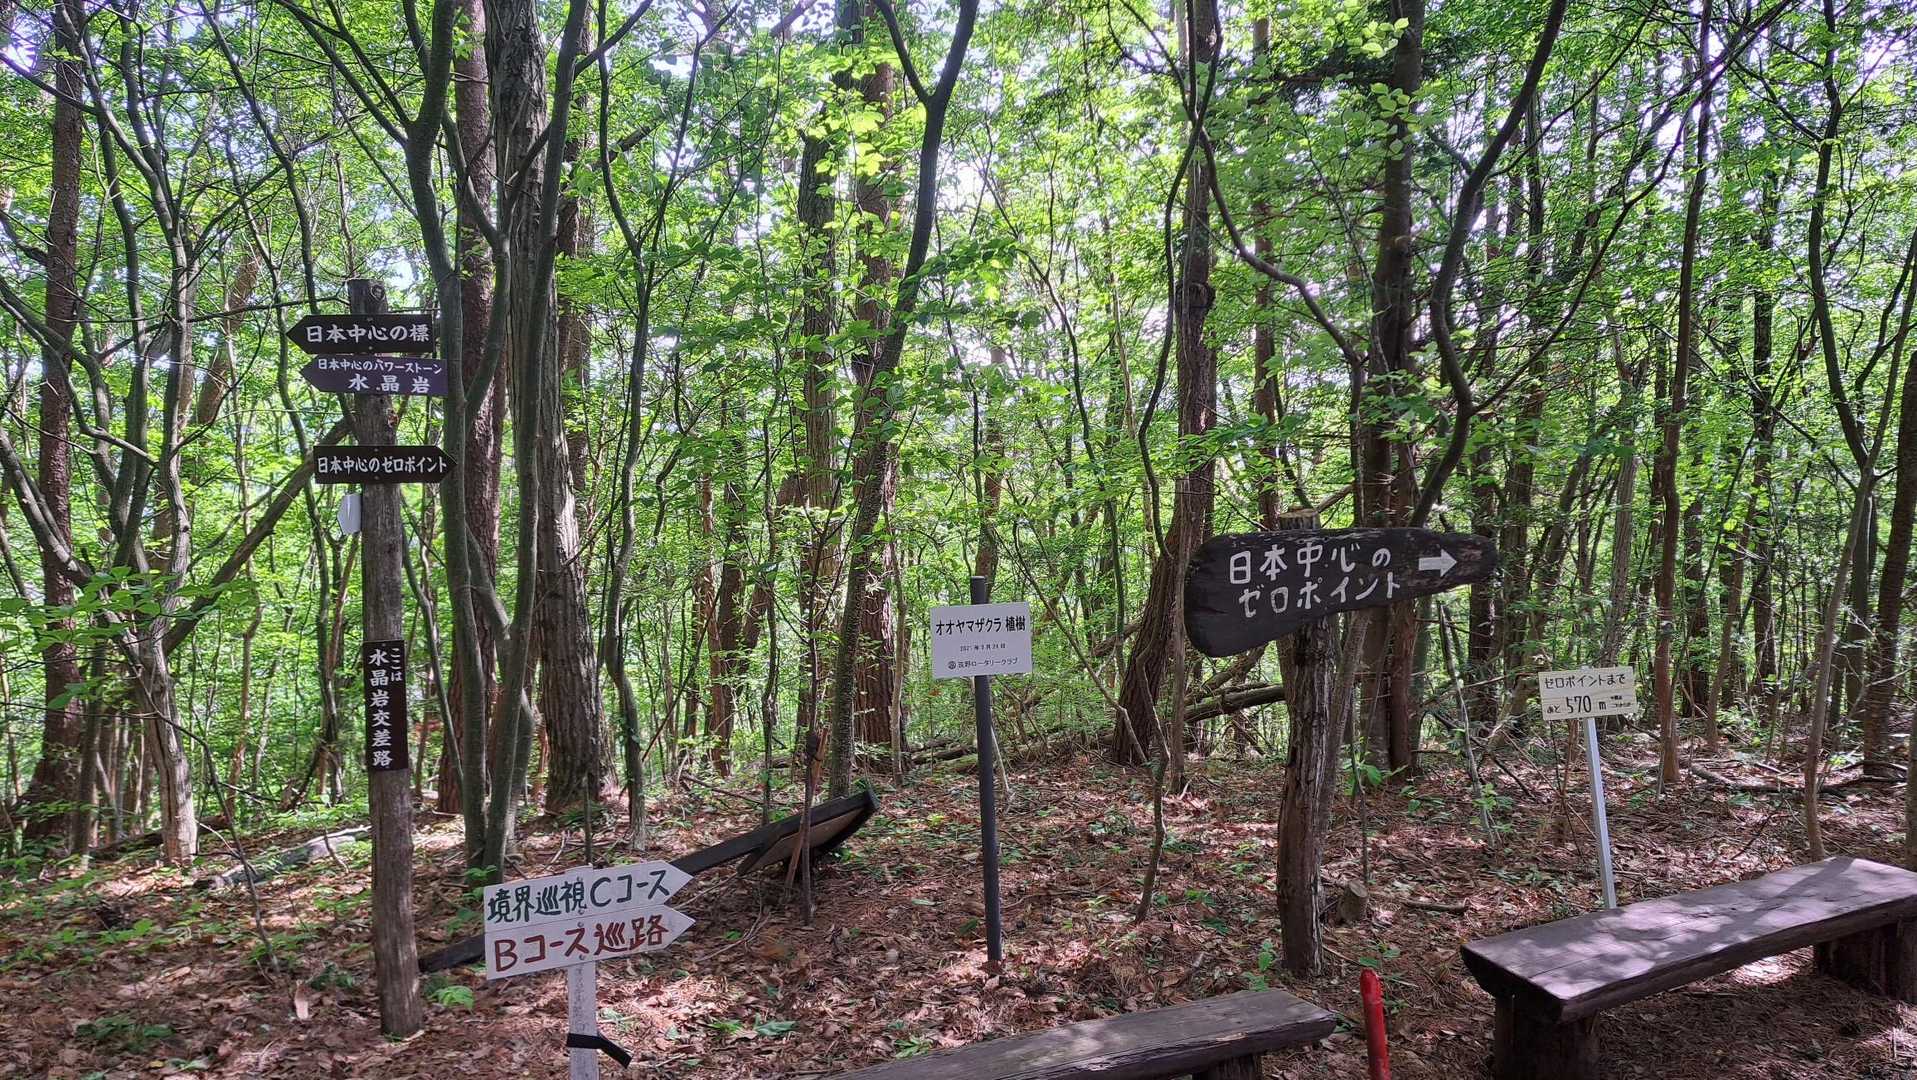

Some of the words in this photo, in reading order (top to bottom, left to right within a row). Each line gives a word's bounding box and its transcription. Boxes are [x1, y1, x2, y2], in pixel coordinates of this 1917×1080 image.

[305, 323, 430, 343] 日本中心の標
[318, 358, 442, 374] 日本中心のパワーストーン
[317, 455, 447, 474] 日本中心のゼロポイント
[1229, 544, 1391, 585] 日本中心の
[1238, 571, 1400, 618] ゼロポイント
[390, 647, 402, 682] ここは
[1544, 673, 1626, 690] ゼロポイントまで
[368, 648, 393, 767] 水晶岩交差路
[1566, 695, 1592, 713] 570
